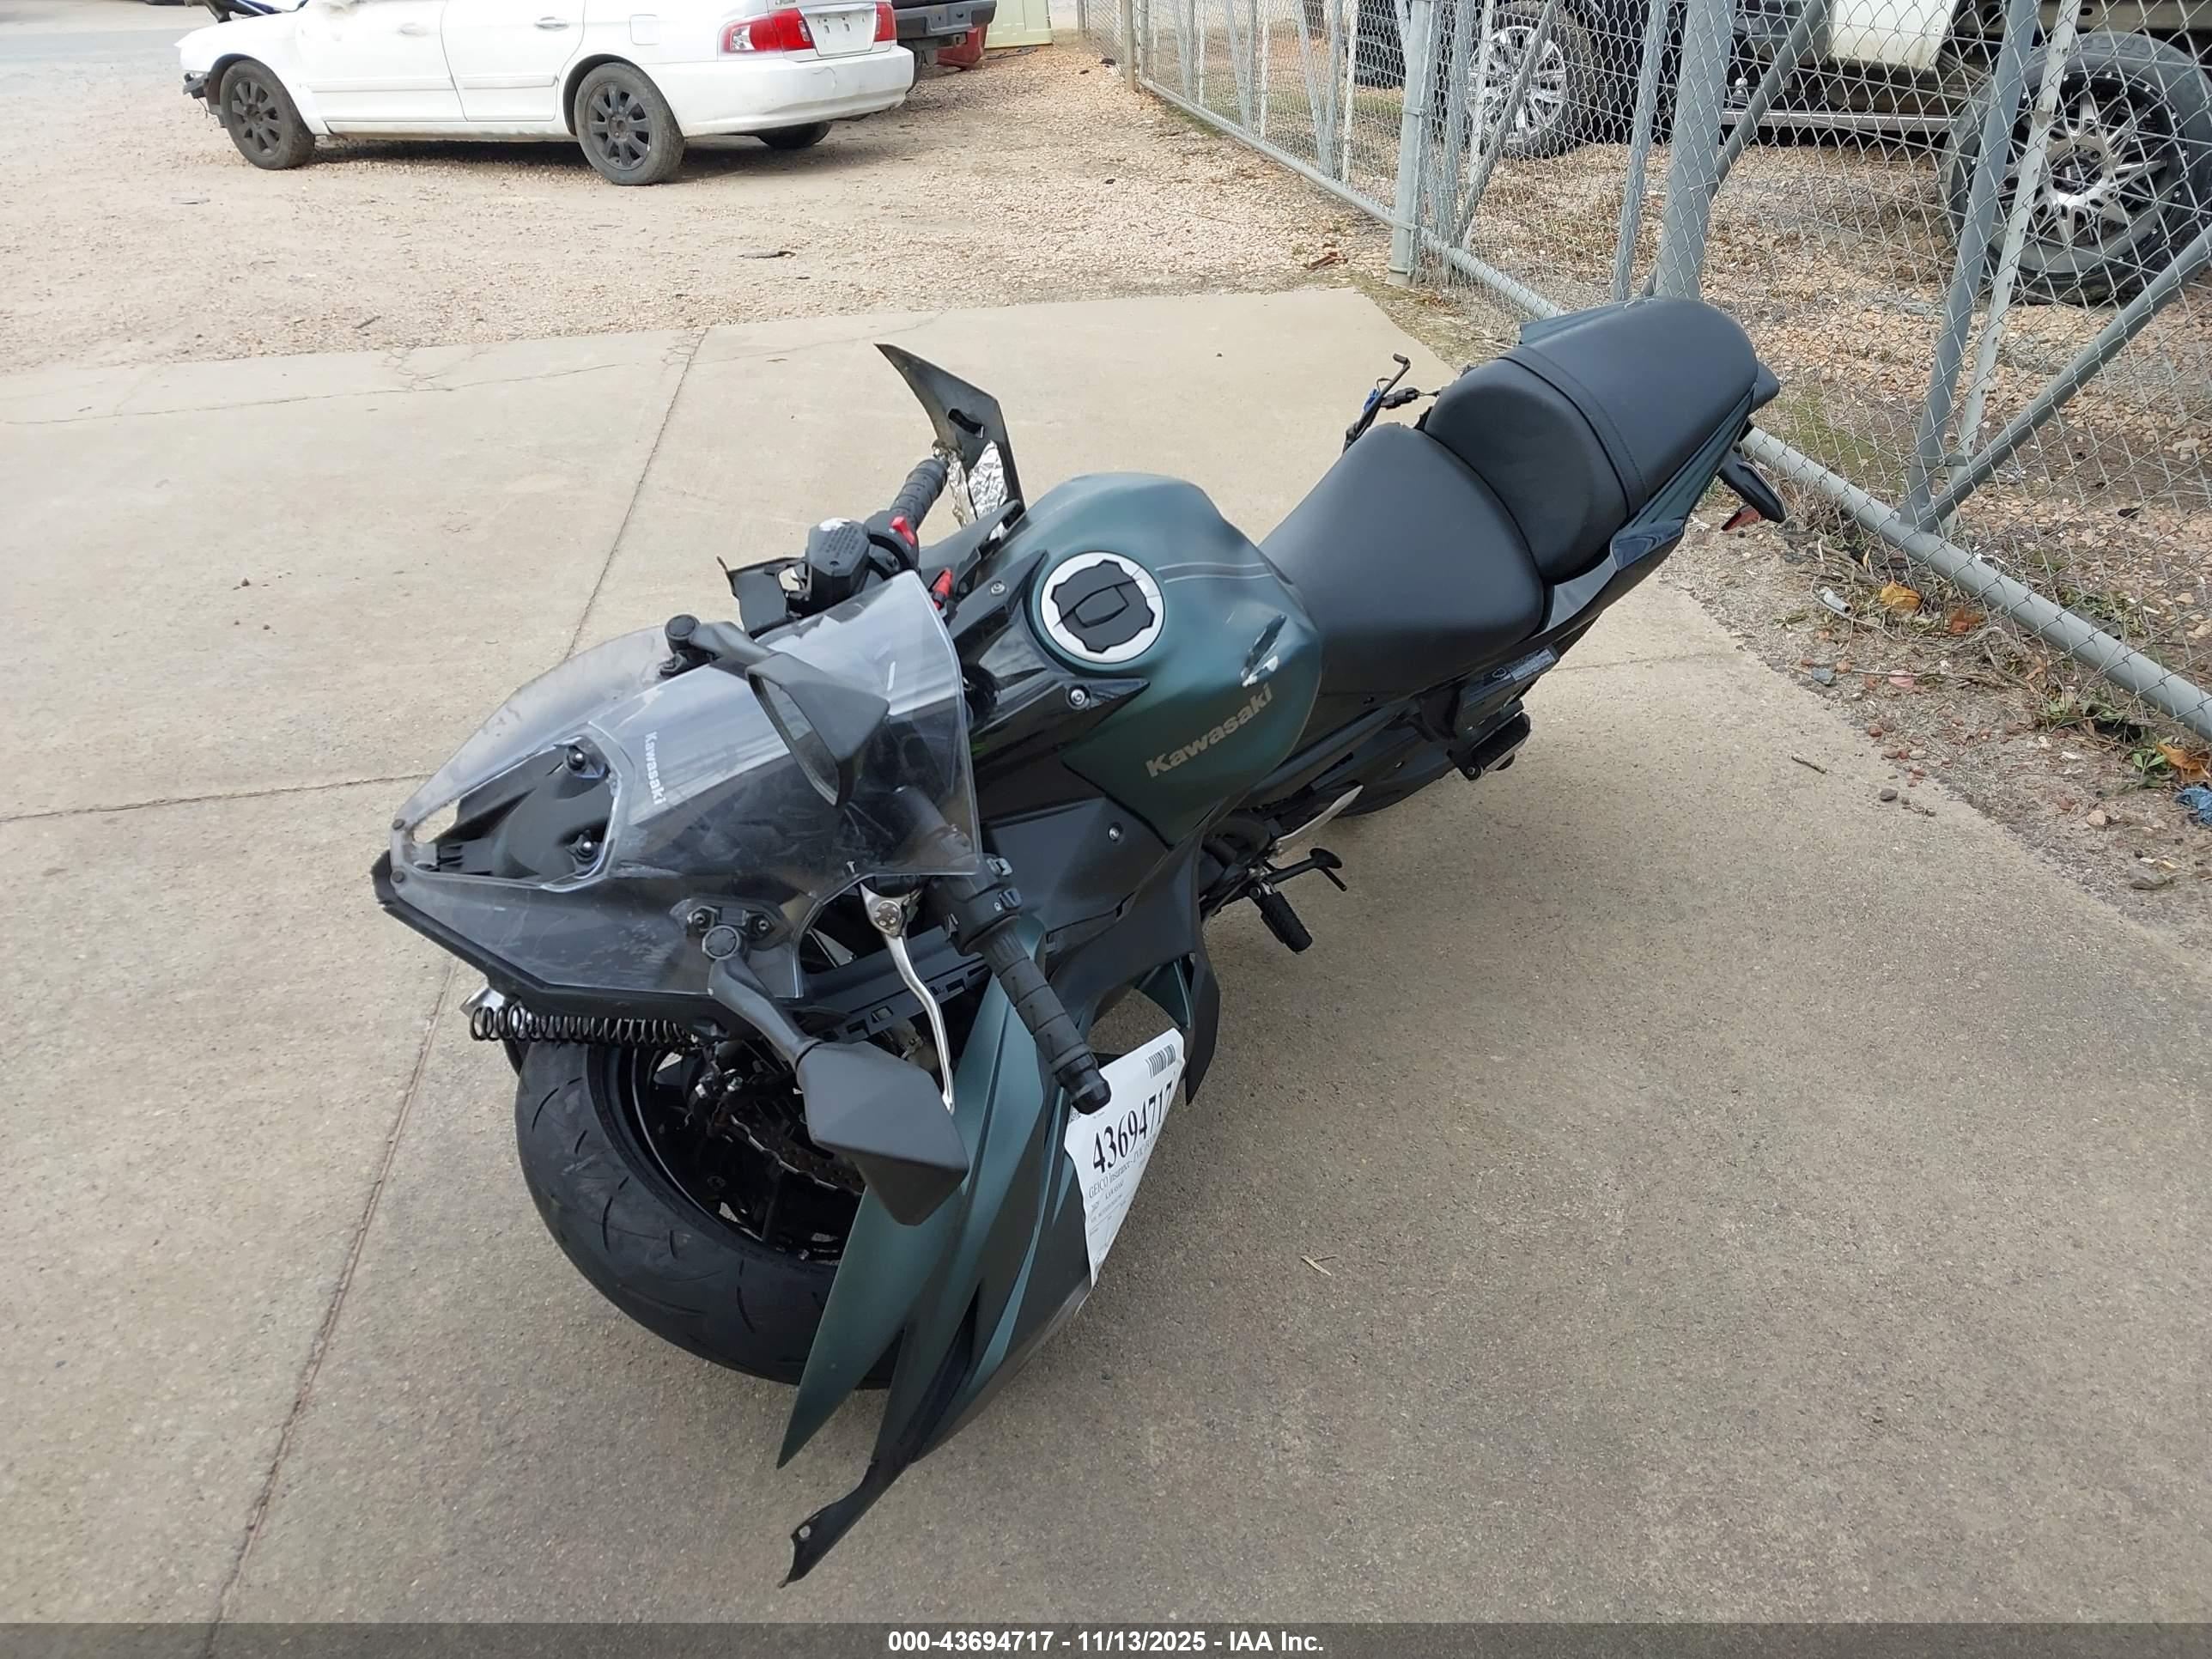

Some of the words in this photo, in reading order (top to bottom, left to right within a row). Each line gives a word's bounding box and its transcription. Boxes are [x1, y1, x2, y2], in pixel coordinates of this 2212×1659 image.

[645, 731, 667, 805] Kawasaki
[1146, 683, 1273, 778] Kawasaki
[1093, 1080, 1173, 1174] 43694717
